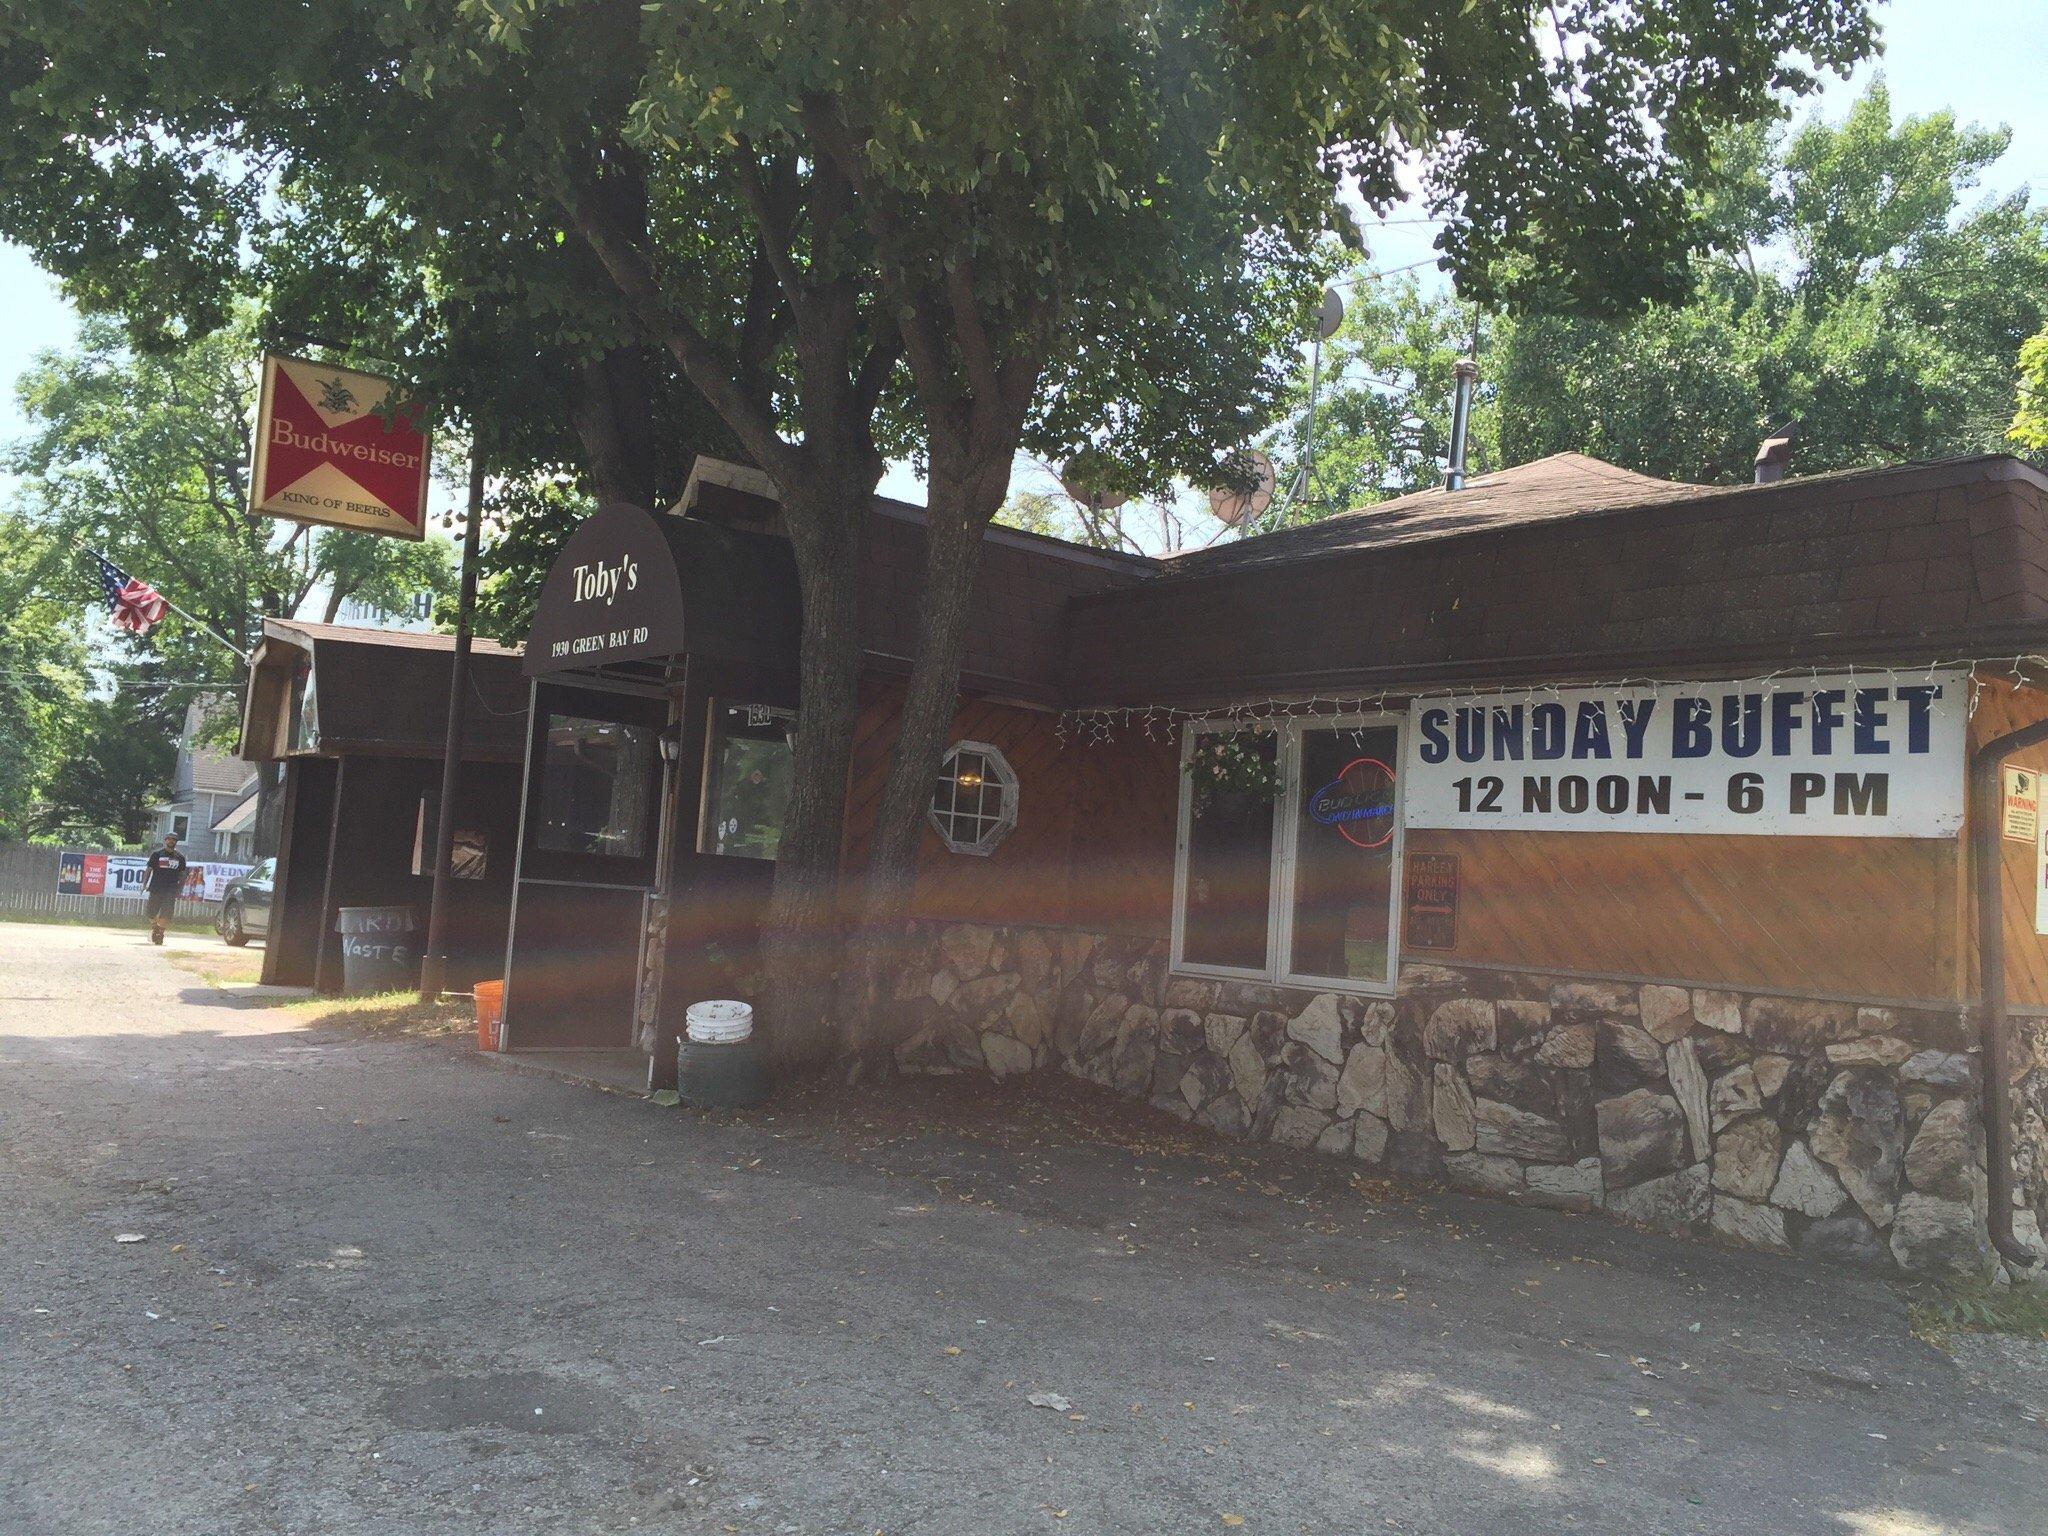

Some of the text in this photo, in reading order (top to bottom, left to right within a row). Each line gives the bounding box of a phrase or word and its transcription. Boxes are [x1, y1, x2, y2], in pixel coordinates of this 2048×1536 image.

[271, 418, 419, 469] Budweiser
[282, 491, 391, 518] KING OF BEERS
[573, 554, 638, 606] Toby's
[551, 626, 649, 658] 1930 GREEN BAY RD
[1419, 684, 1943, 764] SUNDAY BUFFET
[1452, 775, 1505, 813] 12
[1523, 775, 1672, 815] NOON
[1727, 772, 1765, 814] 6
[1789, 773, 1889, 816] PM
[2008, 795, 2036, 812] WARNING
[1411, 876, 1456, 888] PARKING
[1413, 861, 1454, 874] HARLEY
[1417, 889, 1447, 901] ONLY
